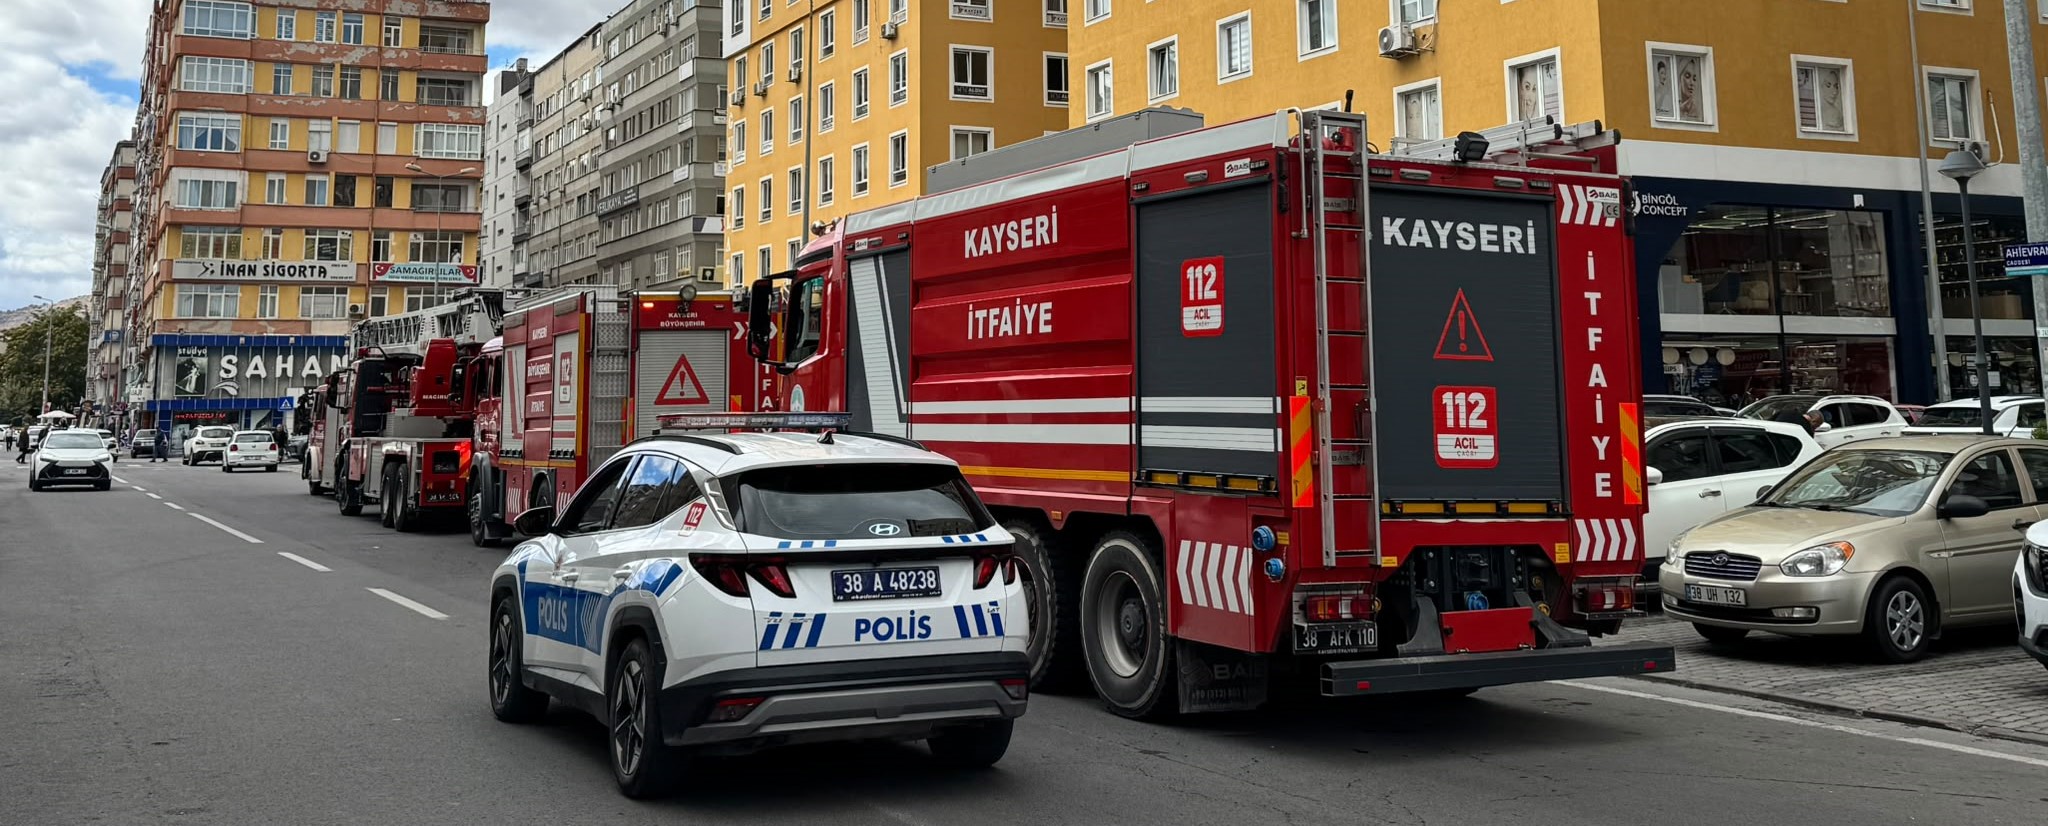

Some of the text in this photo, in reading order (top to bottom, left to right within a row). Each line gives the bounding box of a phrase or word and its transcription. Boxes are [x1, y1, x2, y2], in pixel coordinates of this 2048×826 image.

[1641, 192, 1679, 206] BİNGÖL
[1642, 205, 1688, 216] CONCEPT
[964, 205, 1058, 259] KAYSERİ
[1382, 216, 1536, 255] KAYSERİ
[220, 260, 328, 279] İNAN SİGORTA
[1186, 263, 1217, 301] 112
[967, 298, 1053, 340] İTFAİYE
[1584, 250, 1614, 498] İTFAİYE
[1441, 391, 1488, 429] 112
[1454, 437, 1479, 450] ACİL
[686, 506, 703, 524] 112
[842, 569, 937, 593] 38 A 48238
[1691, 586, 1742, 604] 38 UH 132
[854, 610, 932, 642] POLİS
[1303, 627, 1375, 648] 38 AFK 110
